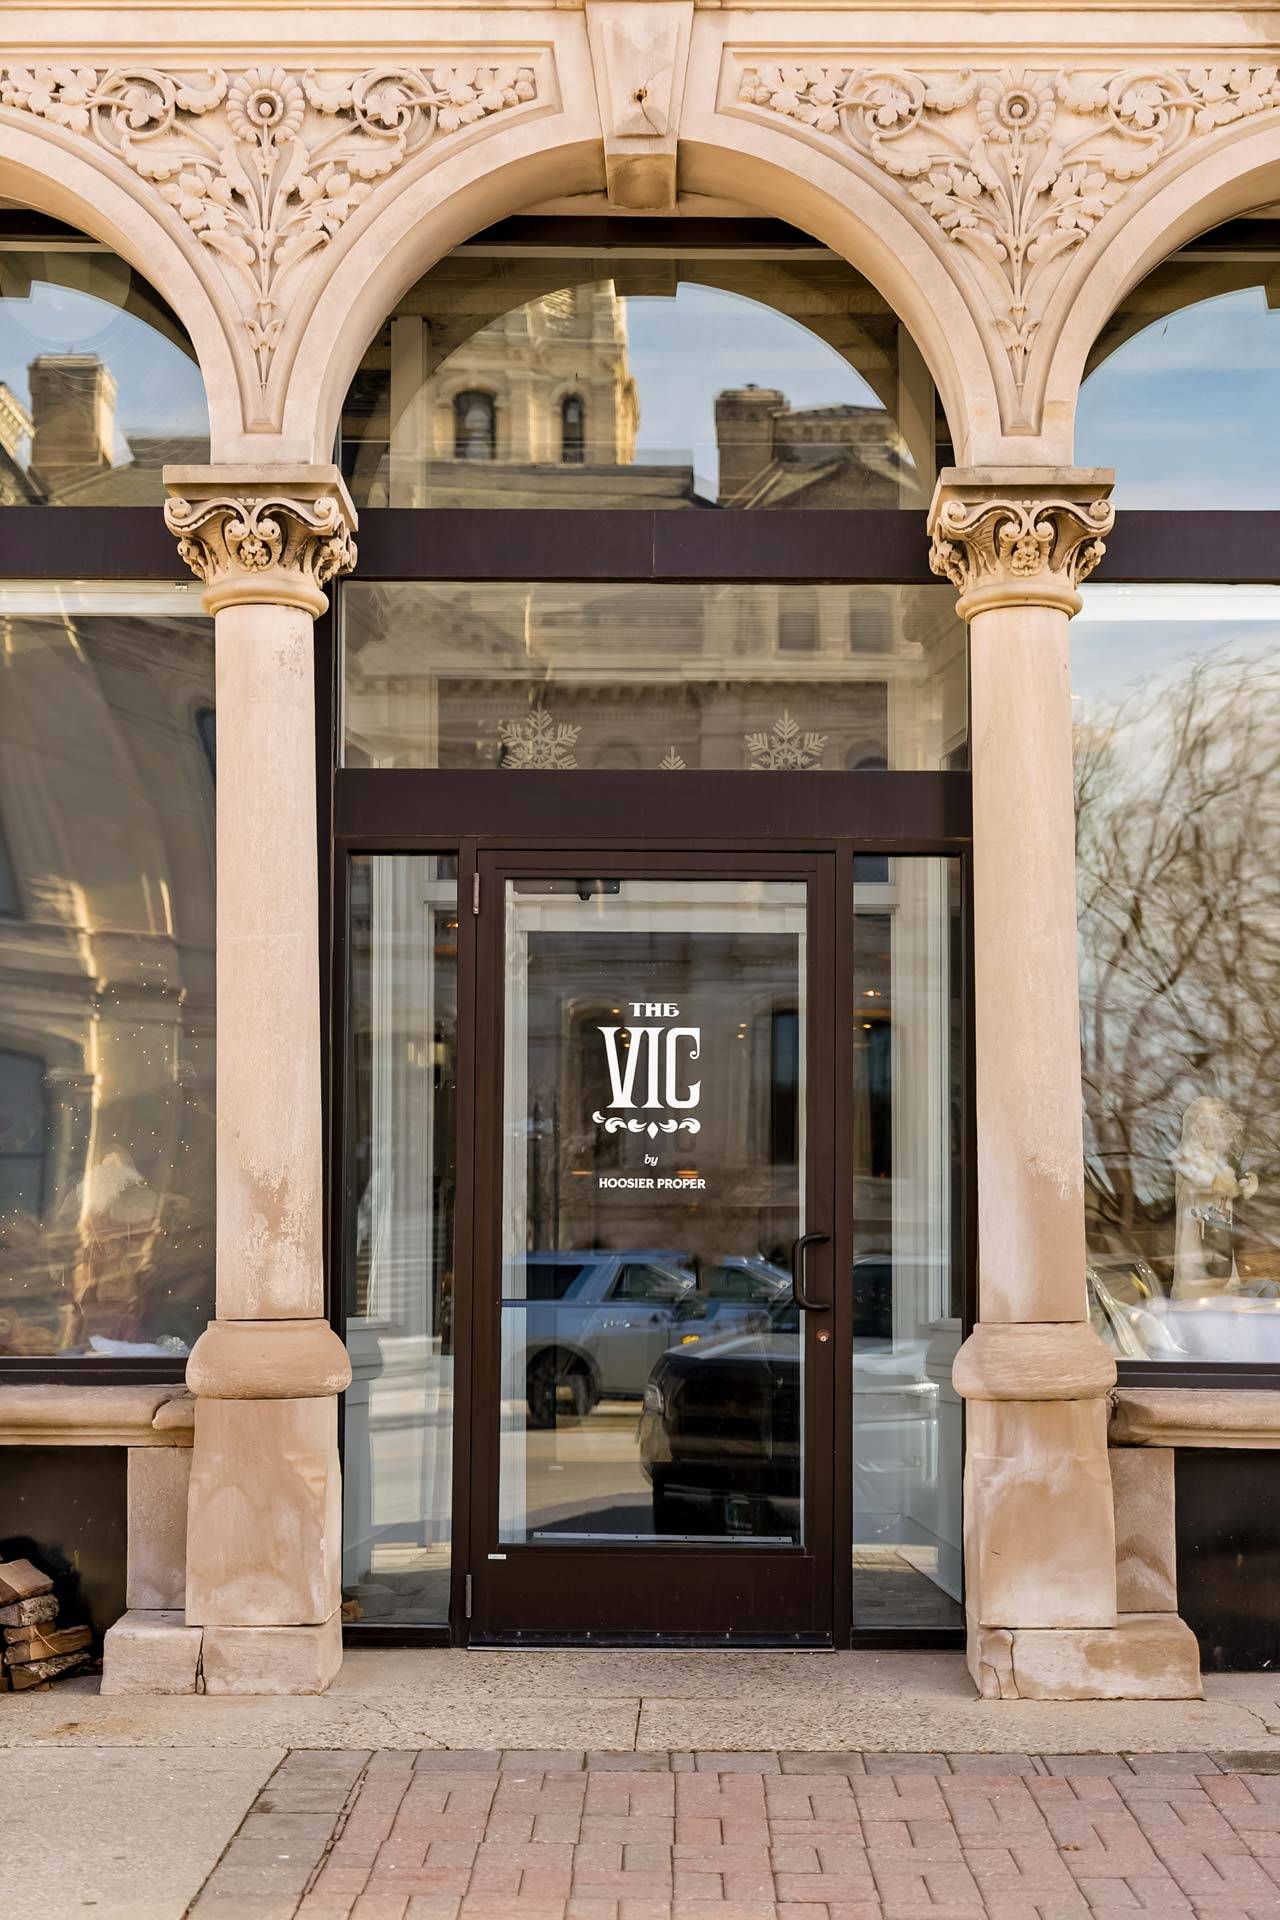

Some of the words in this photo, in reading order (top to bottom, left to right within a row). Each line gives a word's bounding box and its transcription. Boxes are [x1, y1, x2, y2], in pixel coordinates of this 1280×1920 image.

[628, 1002, 680, 1018] THE
[597, 1026, 702, 1109] VIC
[644, 1153, 659, 1167] by
[599, 1177, 655, 1189] HOOSIER
[657, 1178, 706, 1190] PROPER
